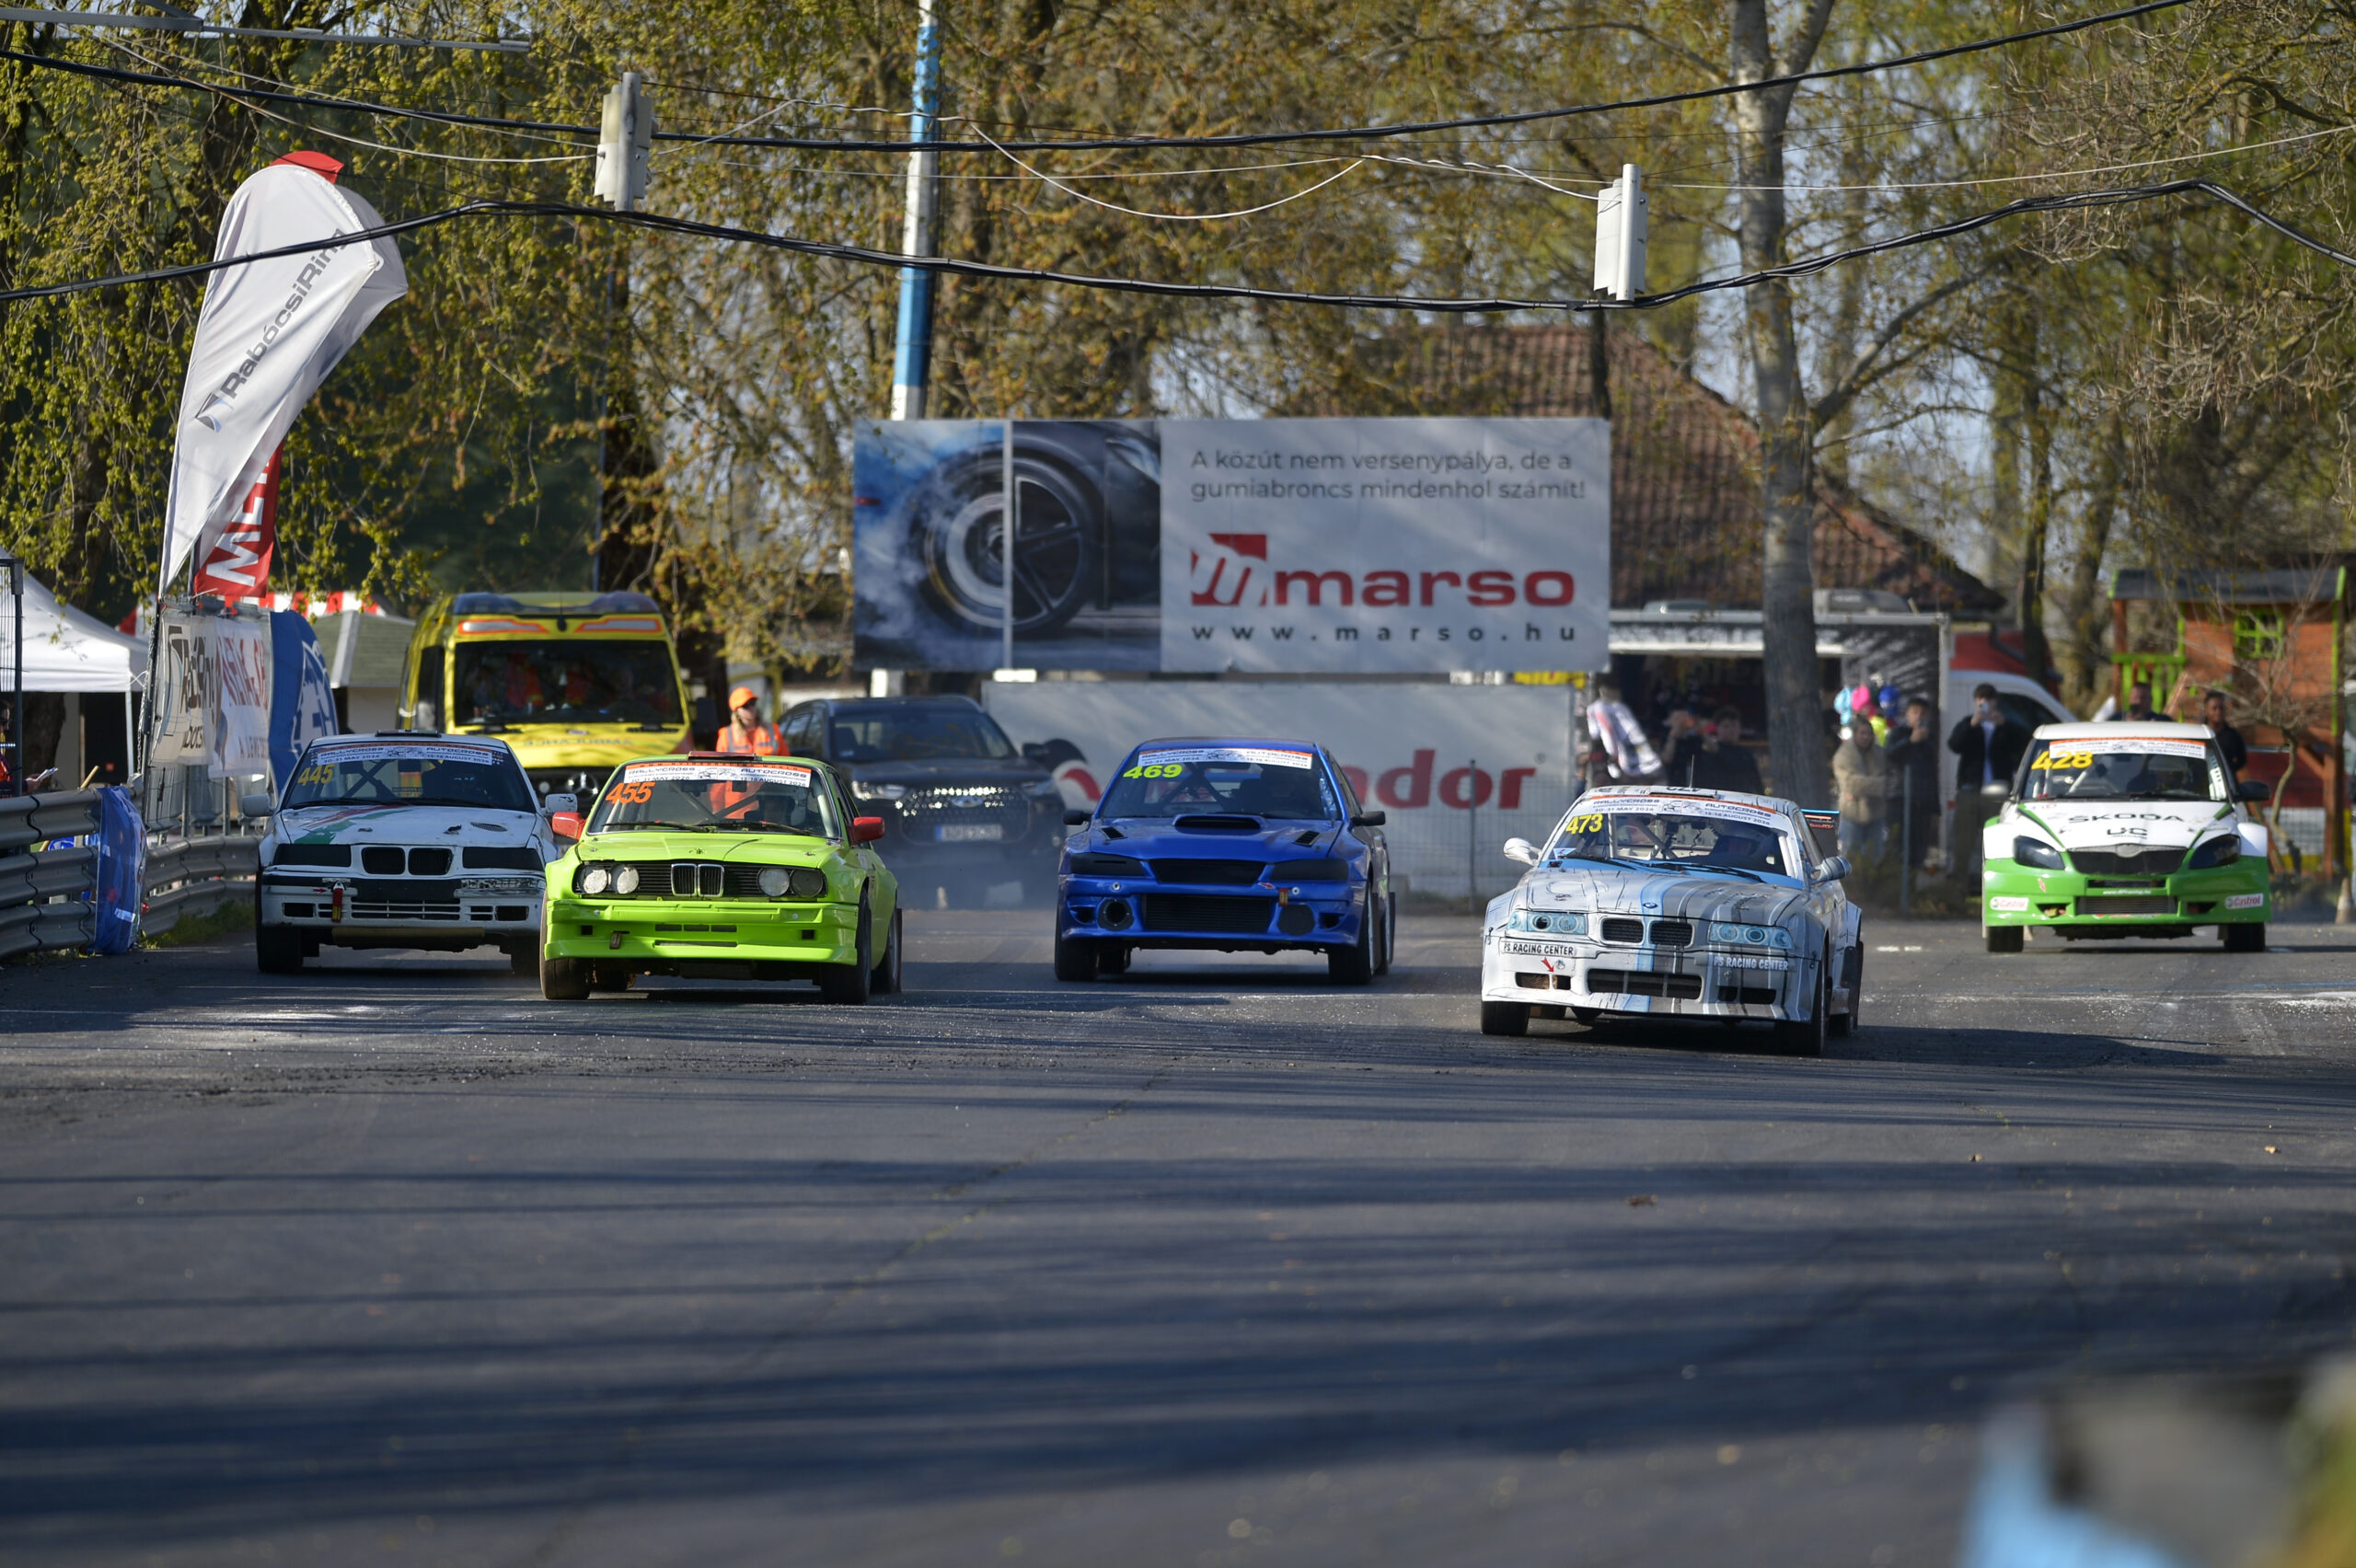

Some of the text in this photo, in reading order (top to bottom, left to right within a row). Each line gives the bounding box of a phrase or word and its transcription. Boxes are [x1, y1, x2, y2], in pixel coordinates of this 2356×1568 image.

[1191, 450, 1208, 468] A
[1216, 449, 1284, 469] közút
[1289, 454, 1345, 469] nem
[1520, 450, 1551, 470] de
[1558, 455, 1573, 469] a
[1191, 478, 1354, 502] gumiabroncs
[1360, 478, 1492, 500] mindenhol
[1274, 570, 1575, 607] marso
[1191, 622, 1576, 643] www.marso.hu
[2031, 750, 2094, 770] 428
[297, 763, 335, 787] 445
[1123, 764, 1183, 779] 469
[605, 781, 656, 805] 455
[1704, 802, 1772, 818] AUTOCROSS
[1723, 813, 1752, 821] AUGUST
[1565, 813, 1604, 835] 473
[2234, 894, 2262, 906] Castrol
[1512, 943, 1542, 954] RACING
[1543, 944, 1574, 955] CENTER
[1714, 956, 1789, 971] PS RACING CENTER
